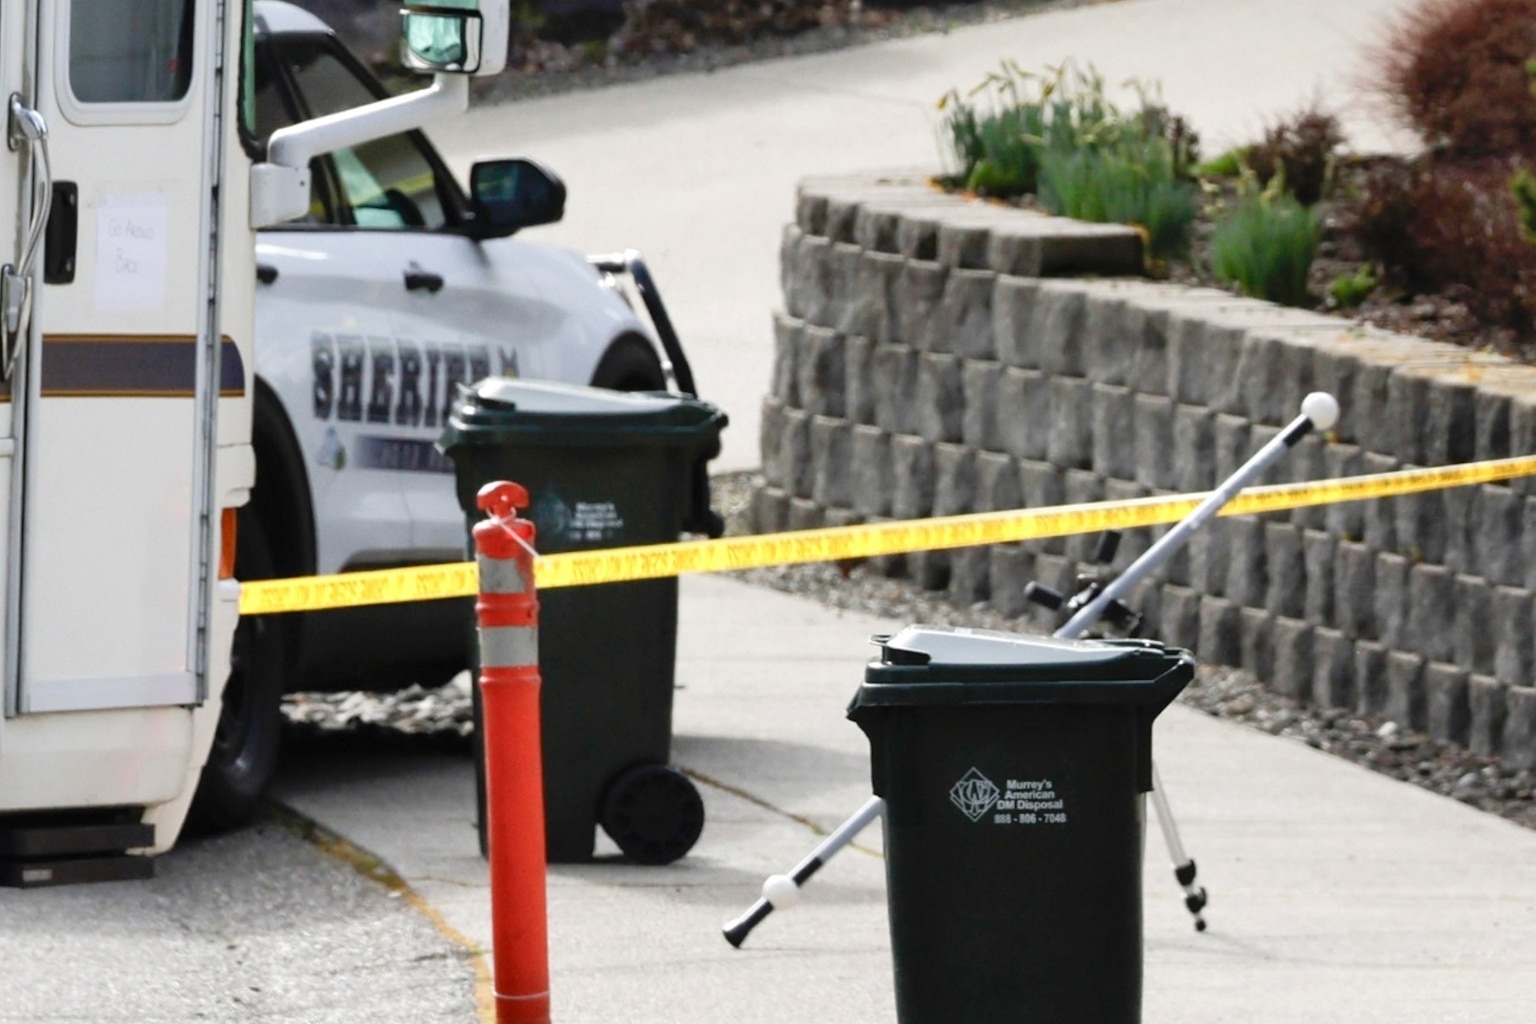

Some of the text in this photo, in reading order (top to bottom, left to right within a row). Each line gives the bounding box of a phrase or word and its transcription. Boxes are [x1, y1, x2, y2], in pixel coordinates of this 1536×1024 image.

[1006, 778, 1052, 791] Murrey's
[1004, 789, 1055, 800] American
[996, 798, 1063, 812] DM Disposal
